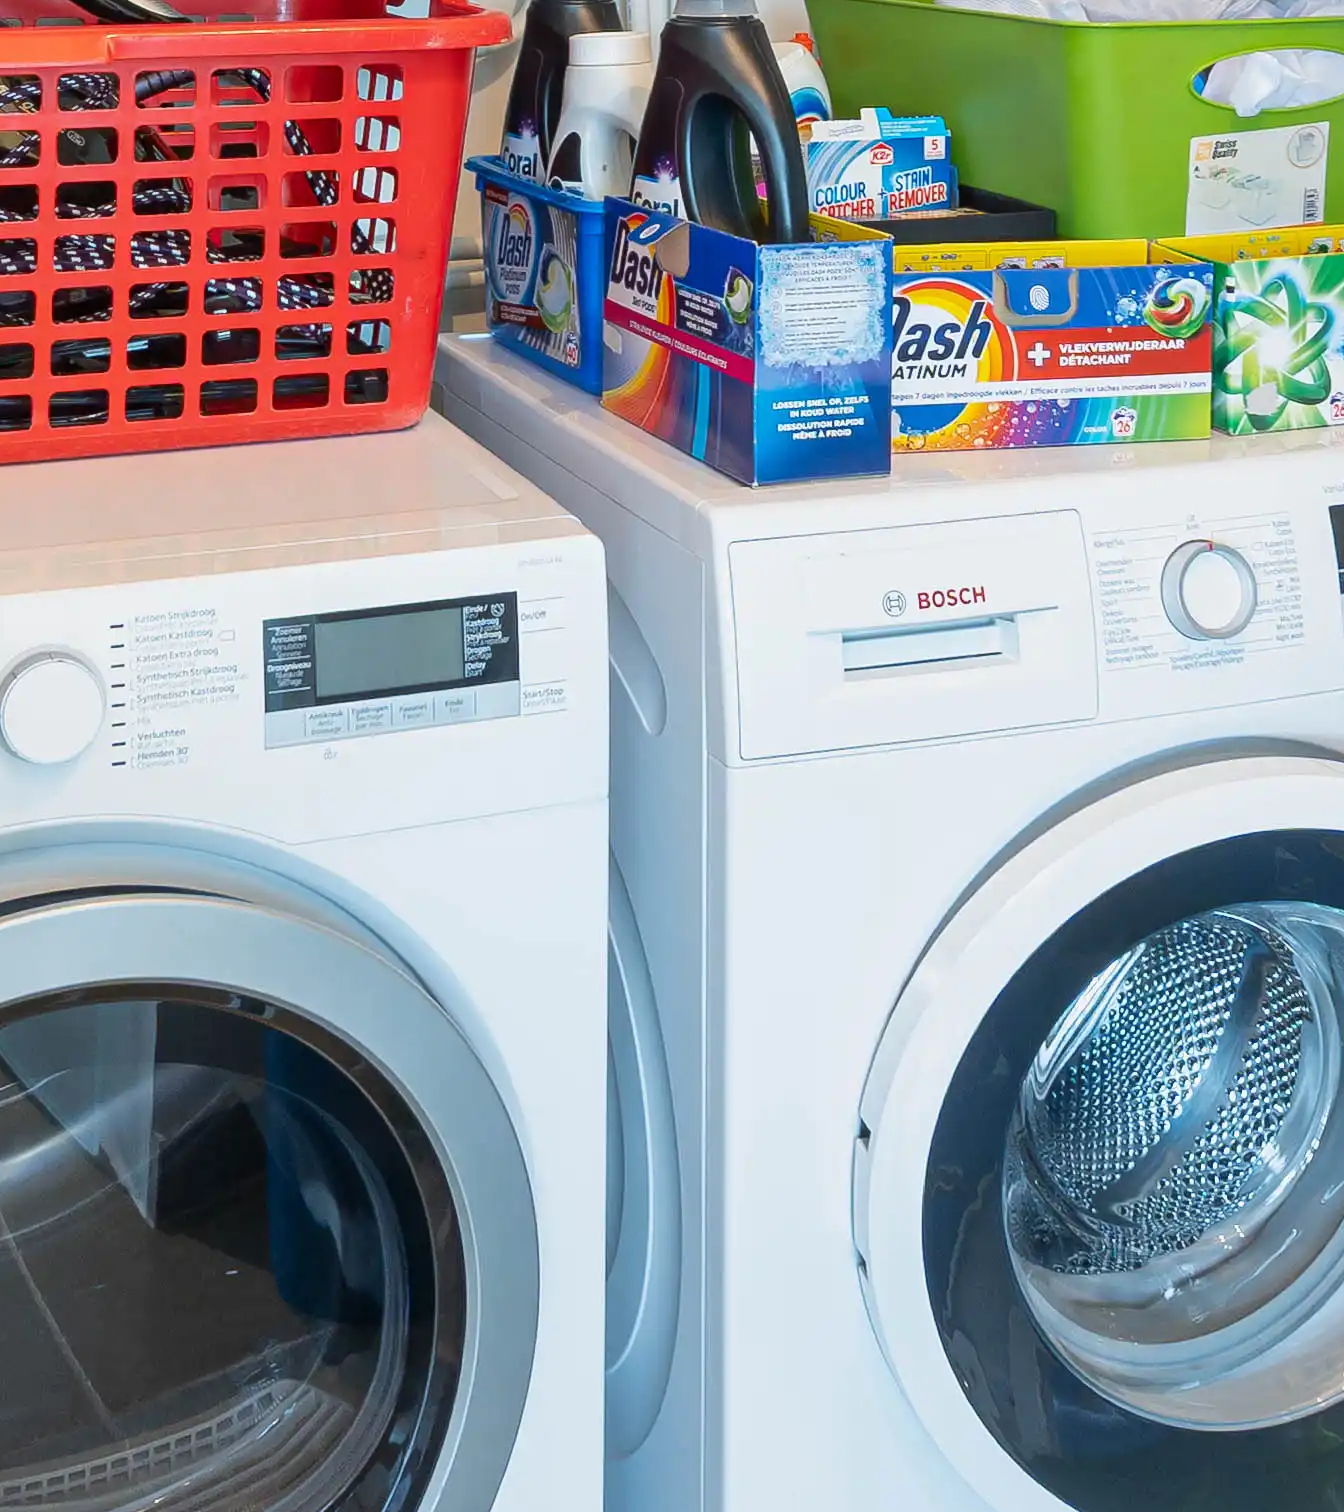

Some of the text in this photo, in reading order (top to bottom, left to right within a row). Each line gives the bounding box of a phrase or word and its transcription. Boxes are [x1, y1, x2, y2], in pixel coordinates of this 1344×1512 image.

[931, 139, 939, 150] 5
[872, 150, 891, 161] K2r
[895, 167, 930, 193] STAIN
[815, 182, 866, 206] COLOUR
[889, 183, 946, 211] REMOVER
[497, 213, 531, 268] Dash
[1059, 339, 1185, 354] VLEKVERWIJDERAAR
[1059, 353, 1131, 367] DÉTACHANT
[892, 364, 967, 380] ATINUM
[772, 398, 805, 410] LOSSEN
[843, 395, 869, 406] ZELFS
[800, 408, 824, 418] KOUD
[826, 406, 854, 416] WATER
[778, 417, 864, 433] DISSOLUTION RAPIDE
[1117, 421, 1131, 433] 26
[826, 428, 852, 439] FROID
[917, 586, 986, 610] BOSCH
